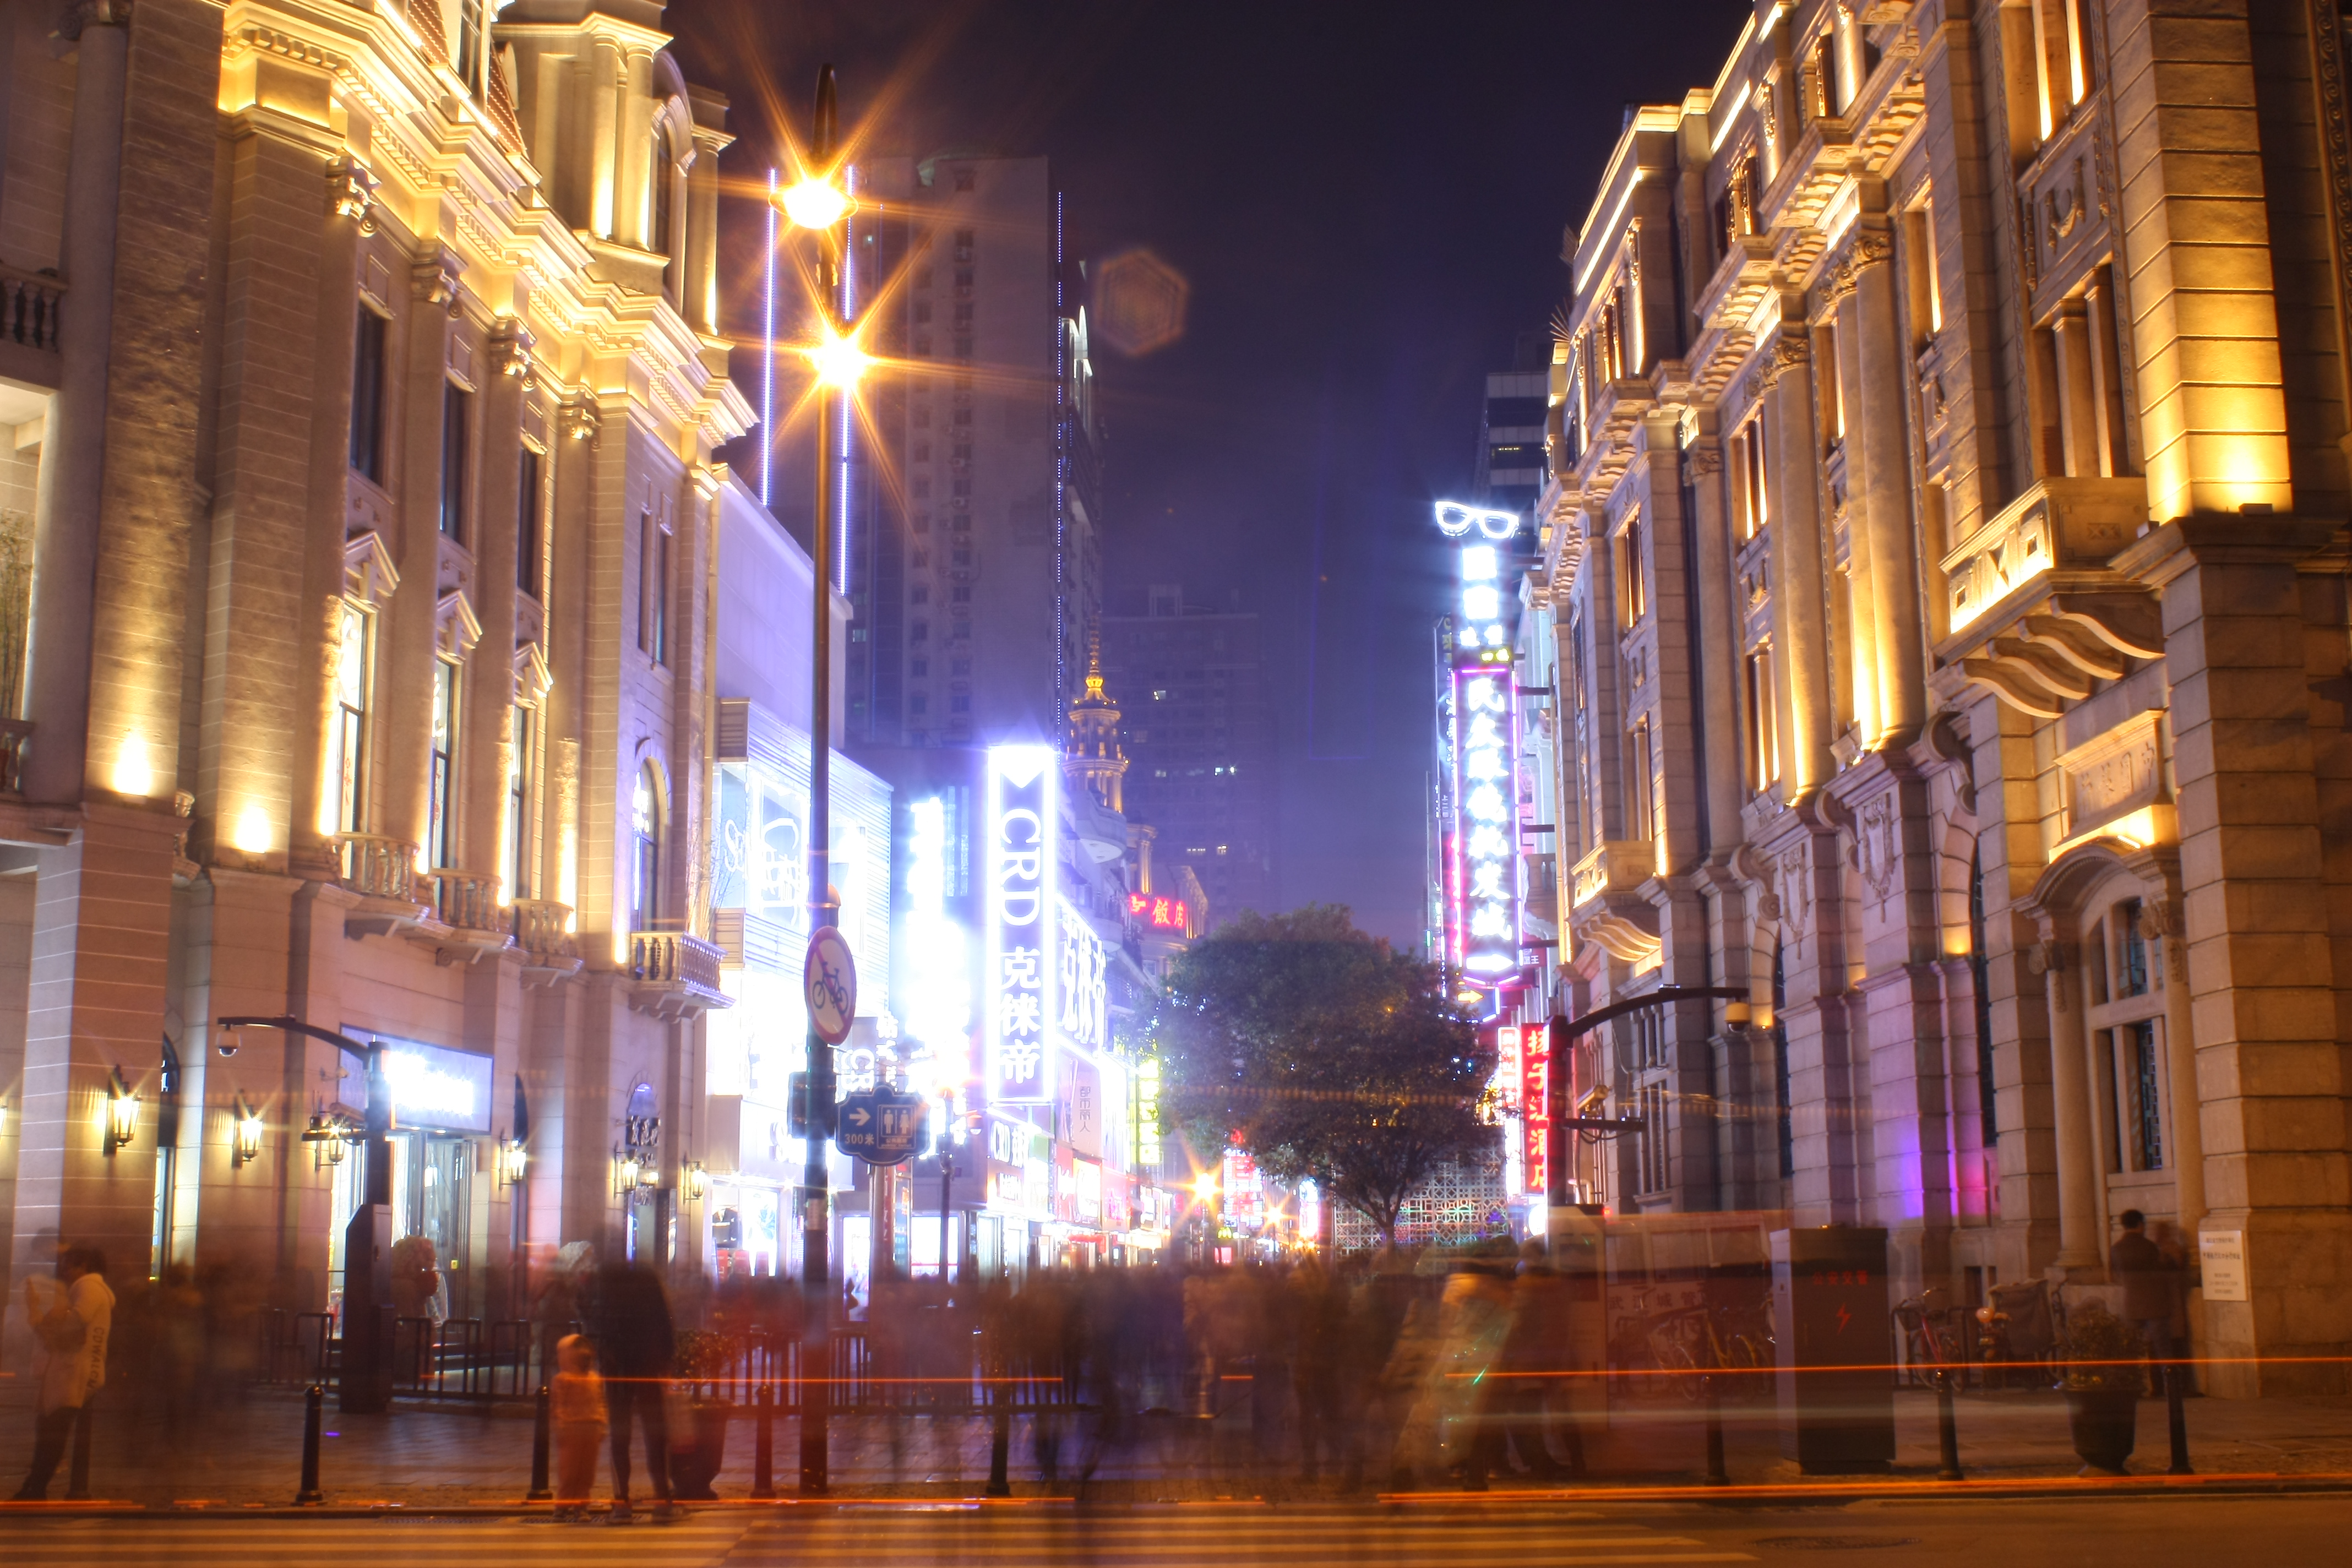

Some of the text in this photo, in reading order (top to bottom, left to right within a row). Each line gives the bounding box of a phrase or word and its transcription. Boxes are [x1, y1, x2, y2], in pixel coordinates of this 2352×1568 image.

[999, 808, 1042, 926] CRD
[999, 945, 1042, 1085] 克徕帝
[844, 1133, 874, 1146] 300米
[1079, 1086, 1091, 1133] 都市丽人
